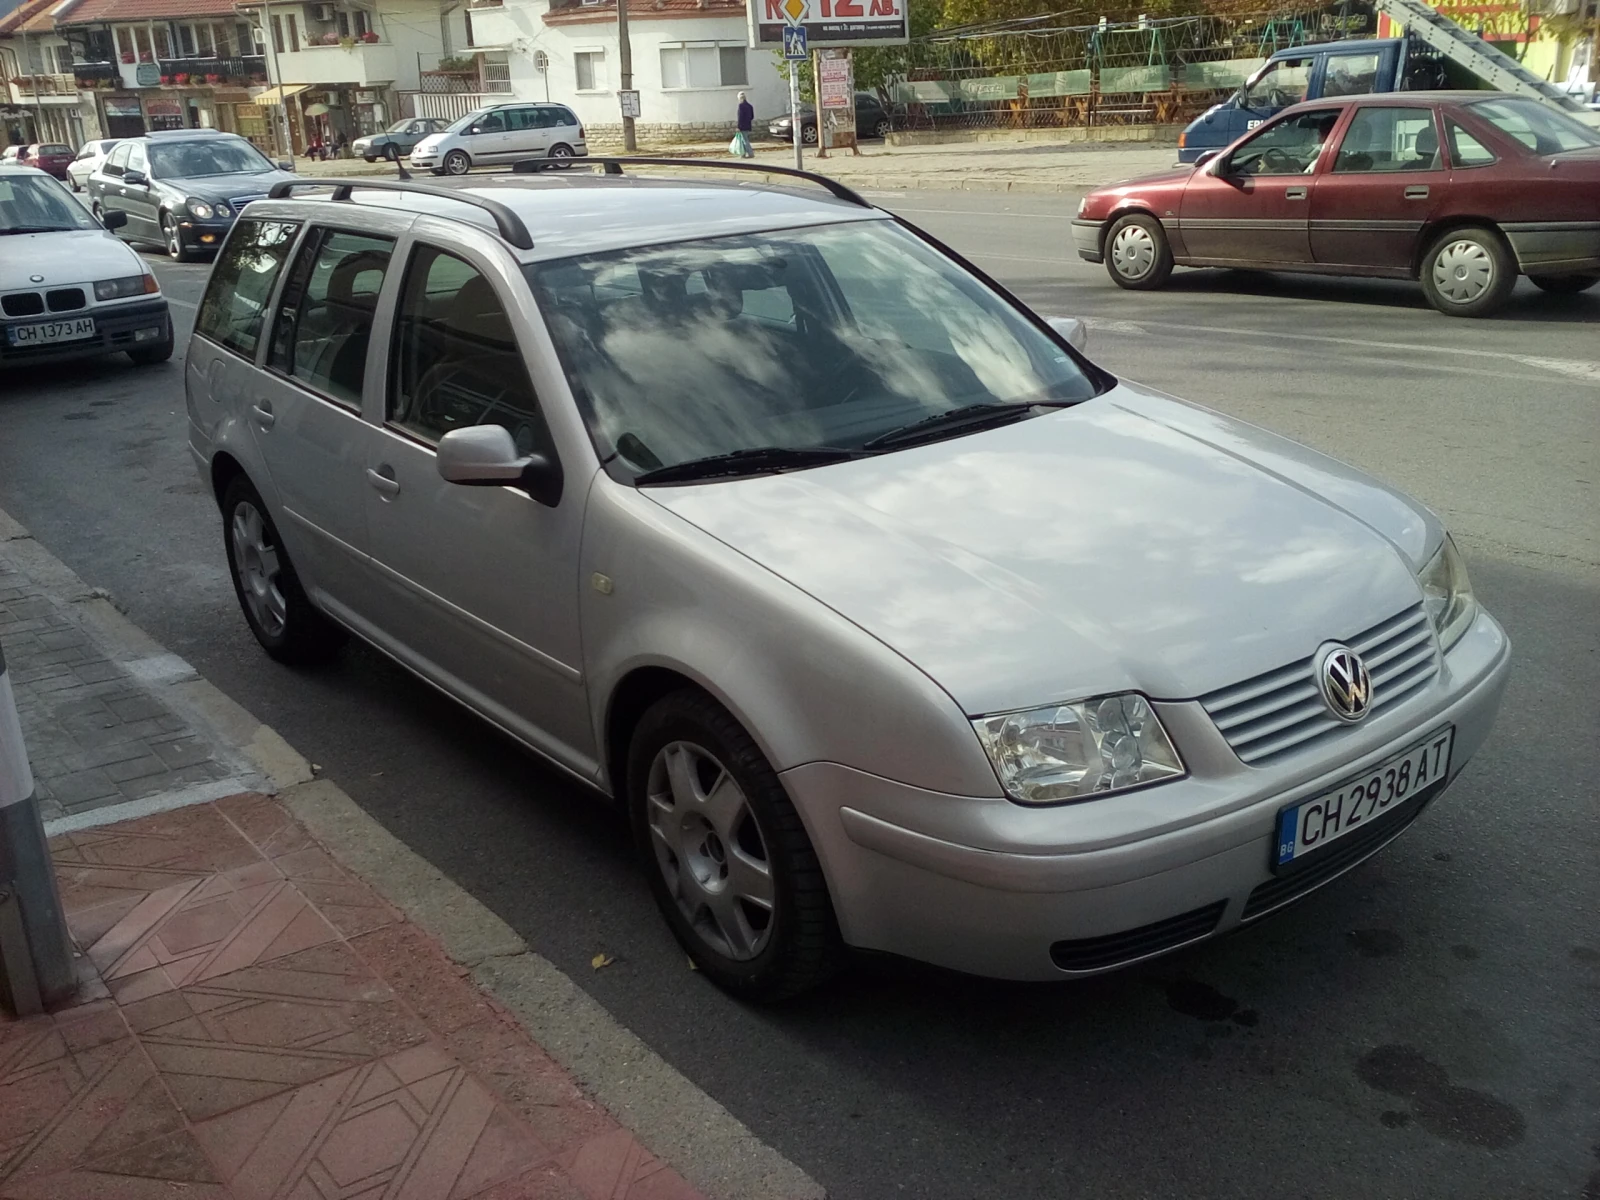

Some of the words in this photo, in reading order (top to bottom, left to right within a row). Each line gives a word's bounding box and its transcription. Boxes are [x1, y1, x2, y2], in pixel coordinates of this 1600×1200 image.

[17, 327, 37, 341] CH
[40, 323, 73, 338] 1373
[76, 319, 93, 334] AH
[1323, 650, 1371, 718] VW
[1302, 794, 1343, 845] CH
[1345, 759, 1412, 827] 2938
[1413, 737, 1447, 788] AT
[1280, 841, 1294, 856] BG
